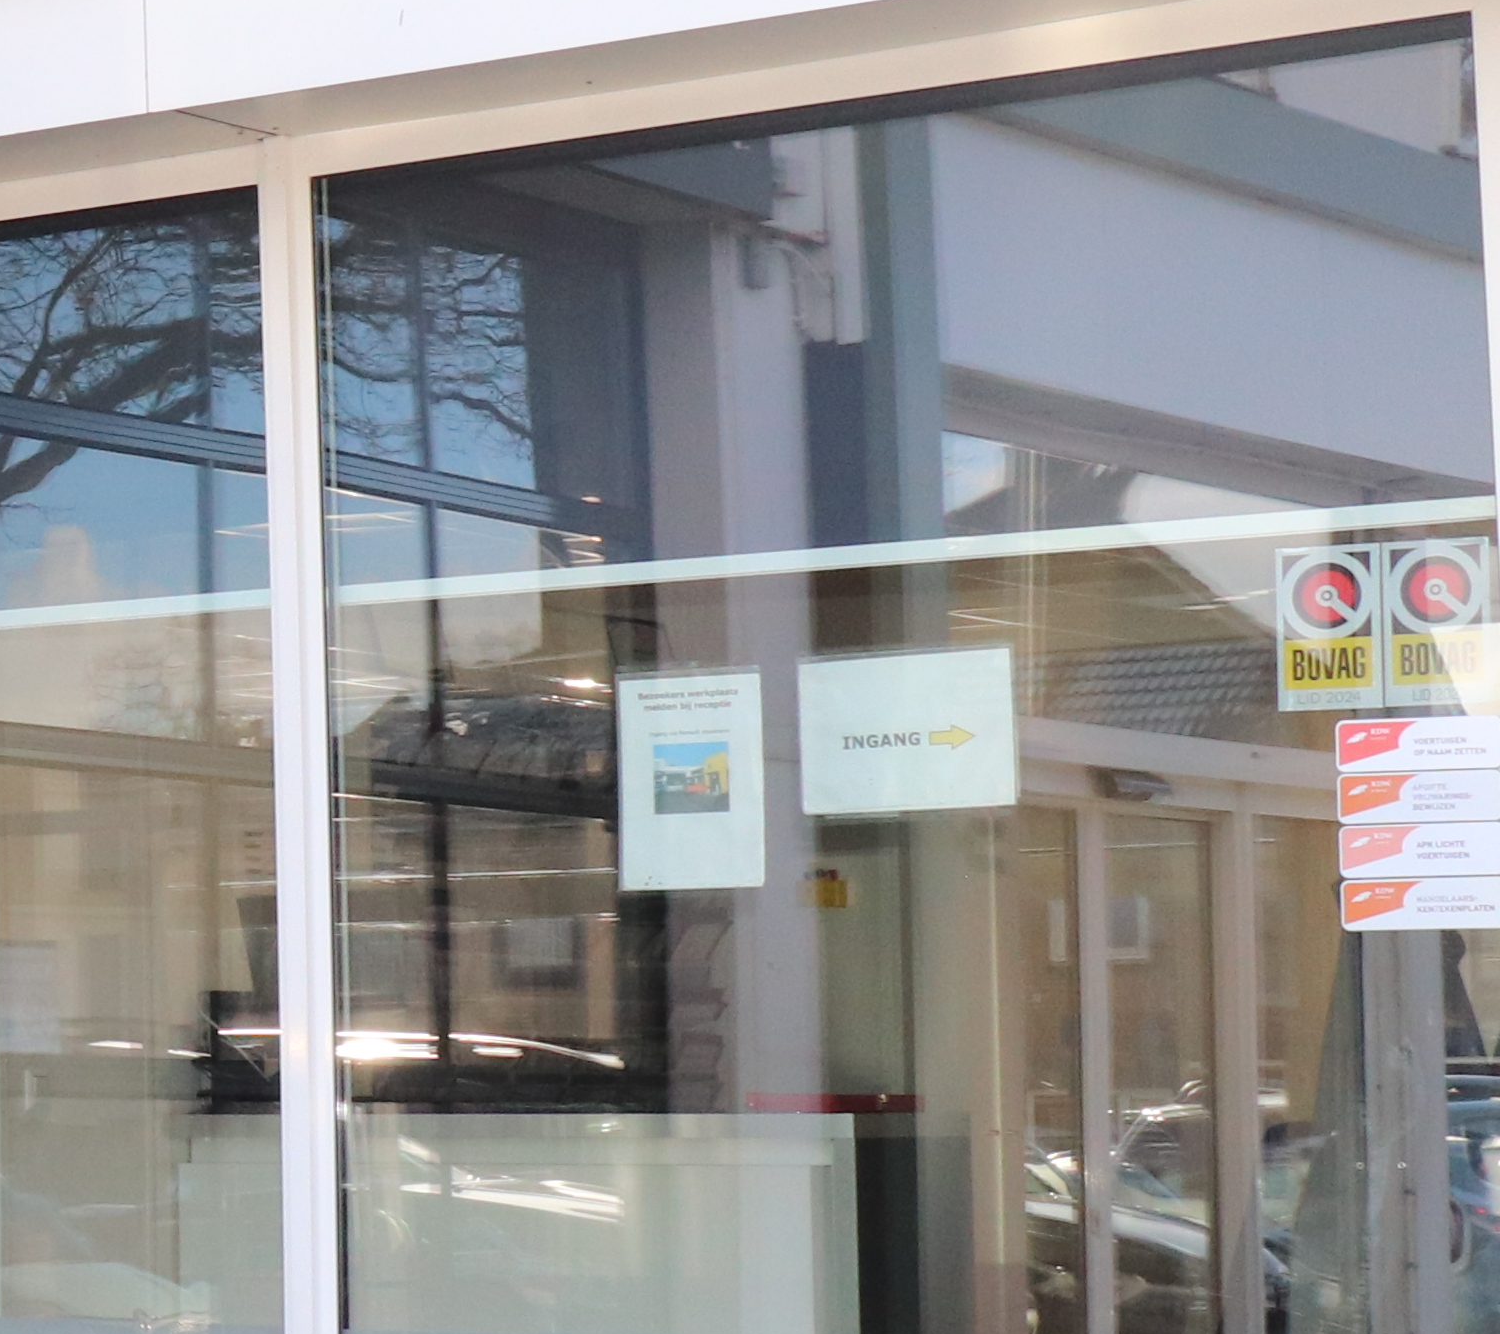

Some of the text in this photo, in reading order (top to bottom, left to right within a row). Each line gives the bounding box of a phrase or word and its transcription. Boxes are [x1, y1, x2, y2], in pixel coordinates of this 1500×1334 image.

[1293, 646, 1366, 681] BOVAG
[1401, 641, 1476, 676] BOVAG
[686, 687, 739, 699] werkplaats
[1297, 690, 1362, 705] LID 2024
[1412, 686, 1467, 701] LID 202
[842, 731, 921, 751] INGANG
[1413, 736, 1467, 745] VOERTUIGEN
[1427, 748, 1452, 756] NAAM
[1454, 747, 1487, 755] ZETTEN
[1435, 840, 1466, 848] LICHTE
[1416, 851, 1470, 859] VOERTUIGEN
[1416, 905, 1496, 914] KENTEKENPLATEN
